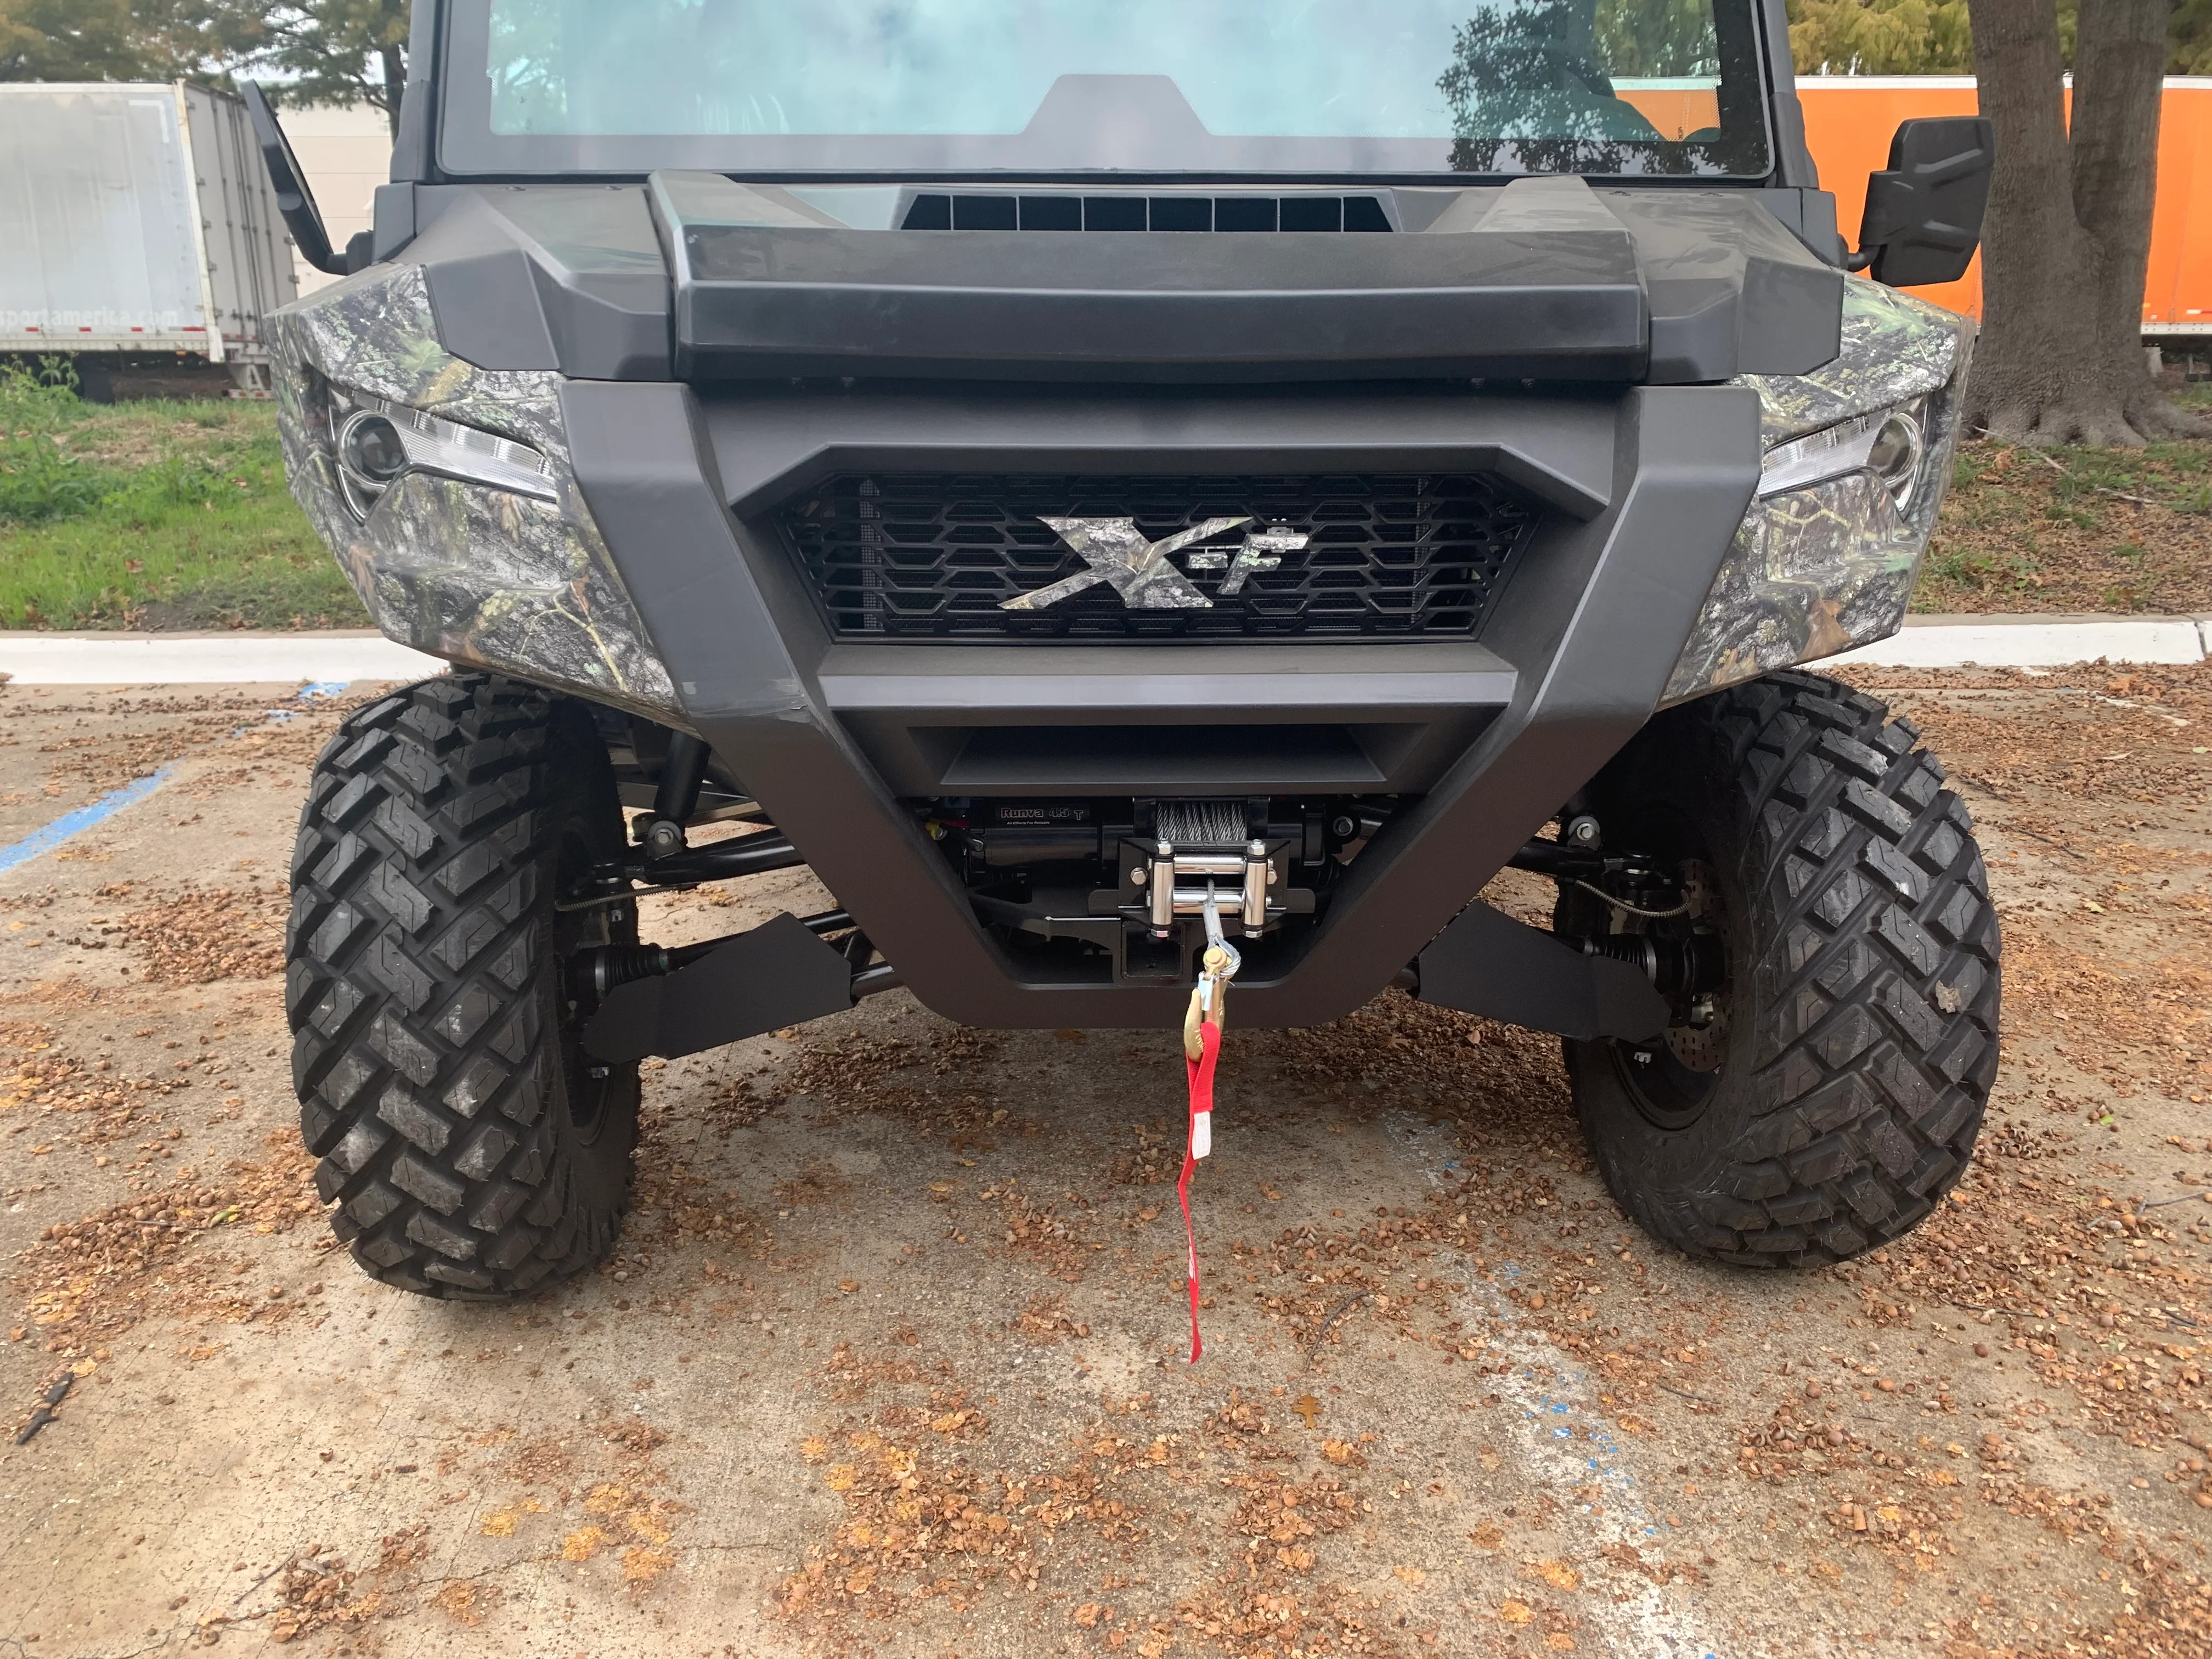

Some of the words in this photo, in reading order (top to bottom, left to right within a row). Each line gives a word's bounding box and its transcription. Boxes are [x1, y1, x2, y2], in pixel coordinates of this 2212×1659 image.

[1001, 808, 1044, 818] Runva
[1048, 808, 1070, 817] 4.5
[1074, 810, 1084, 821] T
